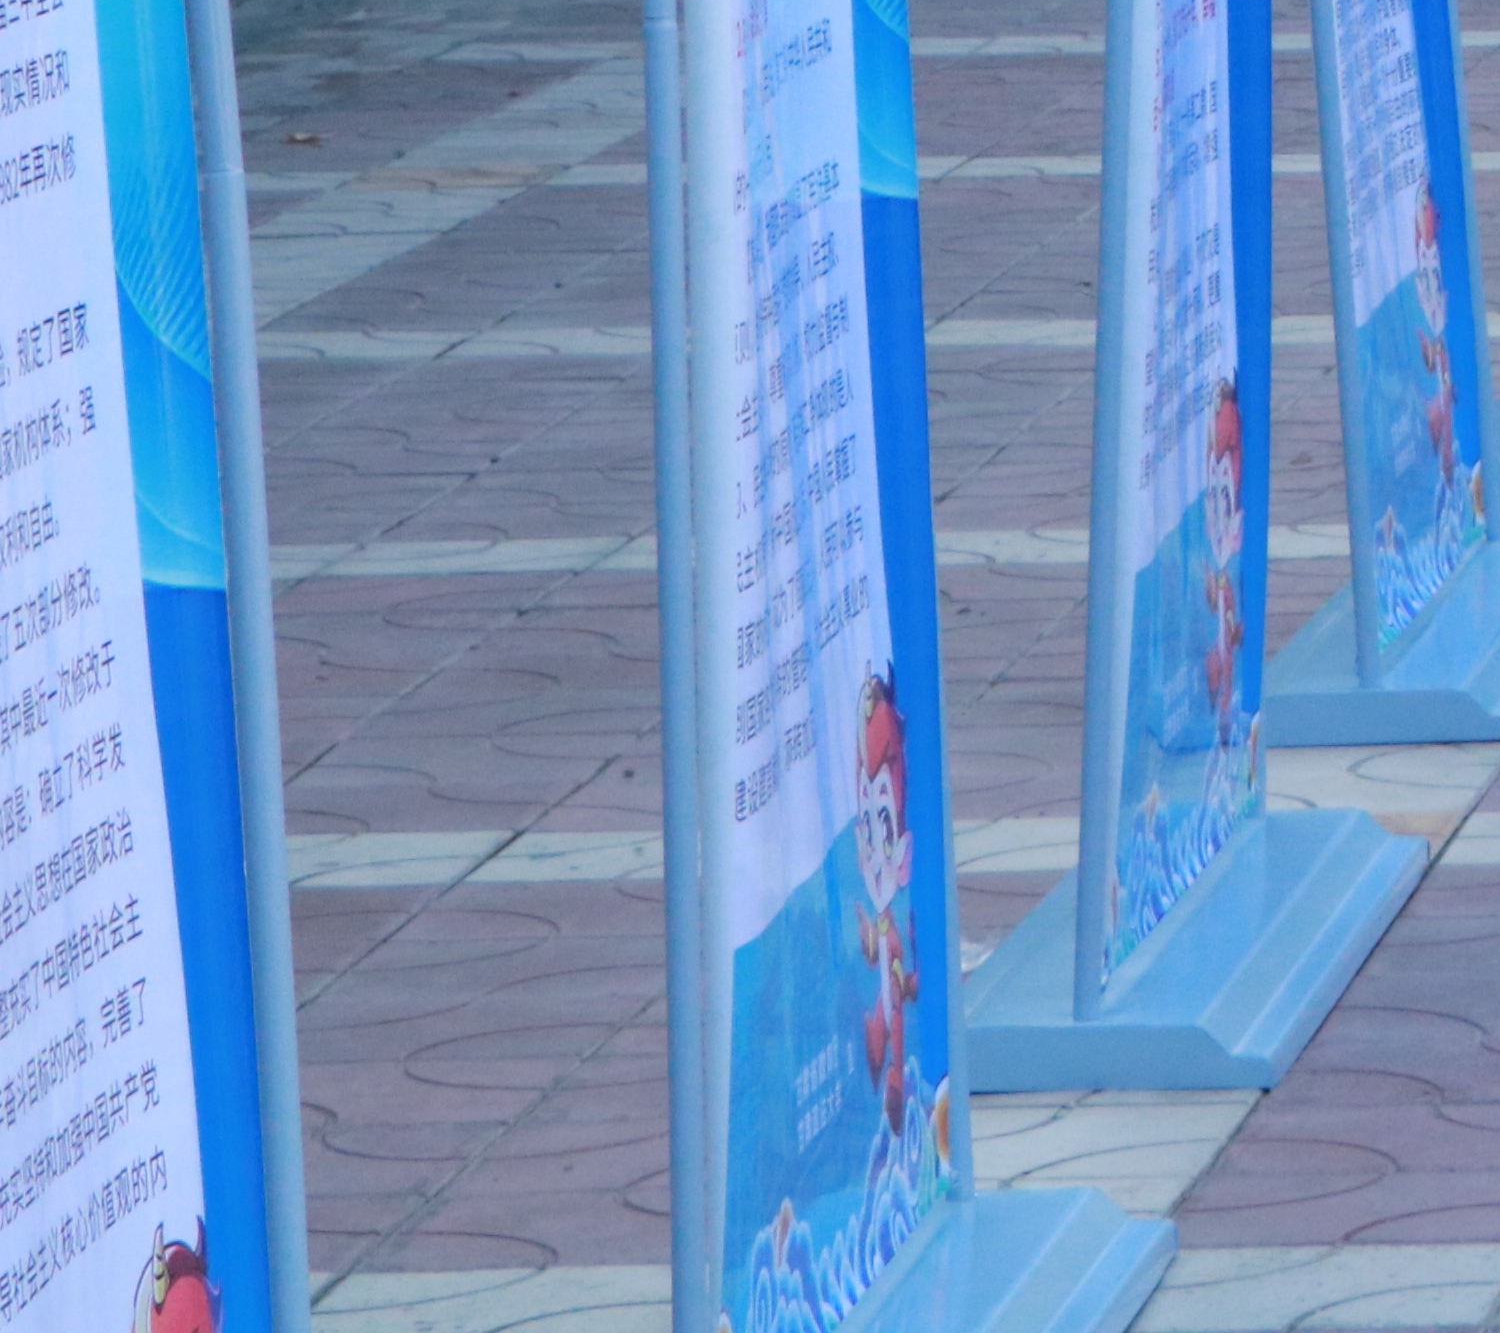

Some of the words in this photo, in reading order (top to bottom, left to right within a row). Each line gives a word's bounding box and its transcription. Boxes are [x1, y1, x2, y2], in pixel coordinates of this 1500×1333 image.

[0, 562, 101, 665] 了五次部分修改。
[0, 722, 127, 852] 容是：确立了科学发
[0, 807, 135, 945] 会主义思想在国家政治
